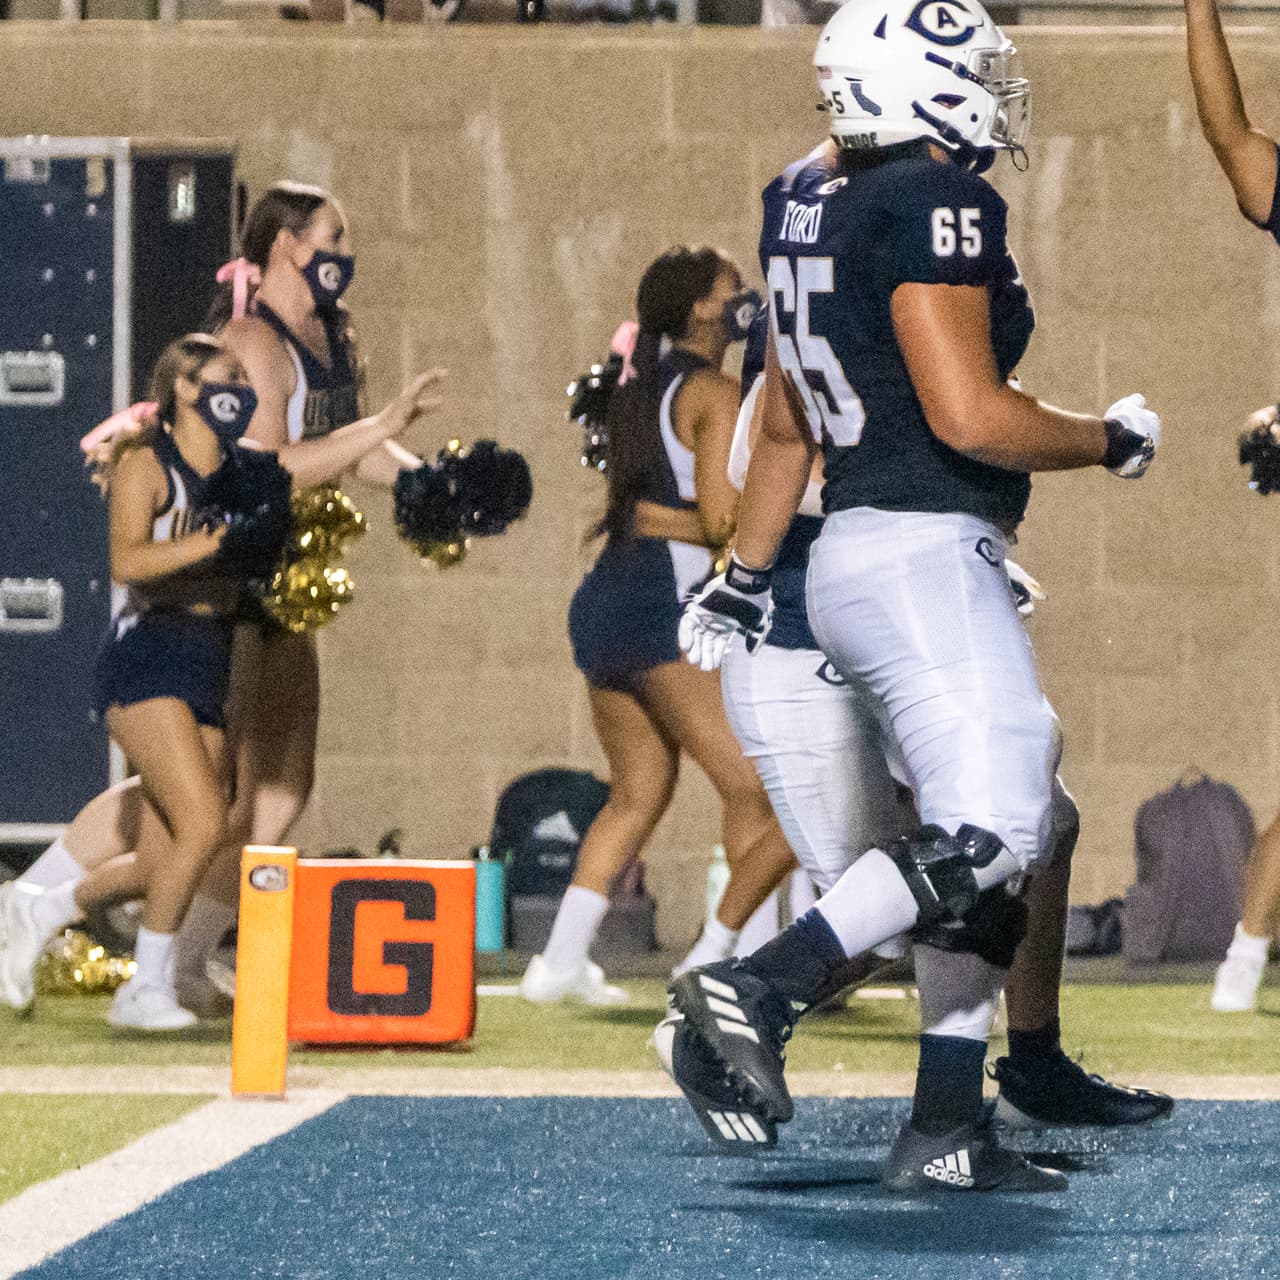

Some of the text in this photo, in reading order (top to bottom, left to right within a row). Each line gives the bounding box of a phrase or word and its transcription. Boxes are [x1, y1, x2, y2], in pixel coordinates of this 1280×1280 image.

[780, 200, 823, 244] FORD
[931, 206, 983, 258] 65
[767, 255, 867, 447] 65
[326, 878, 437, 1017] G
[923, 1164, 976, 1187] adidas
